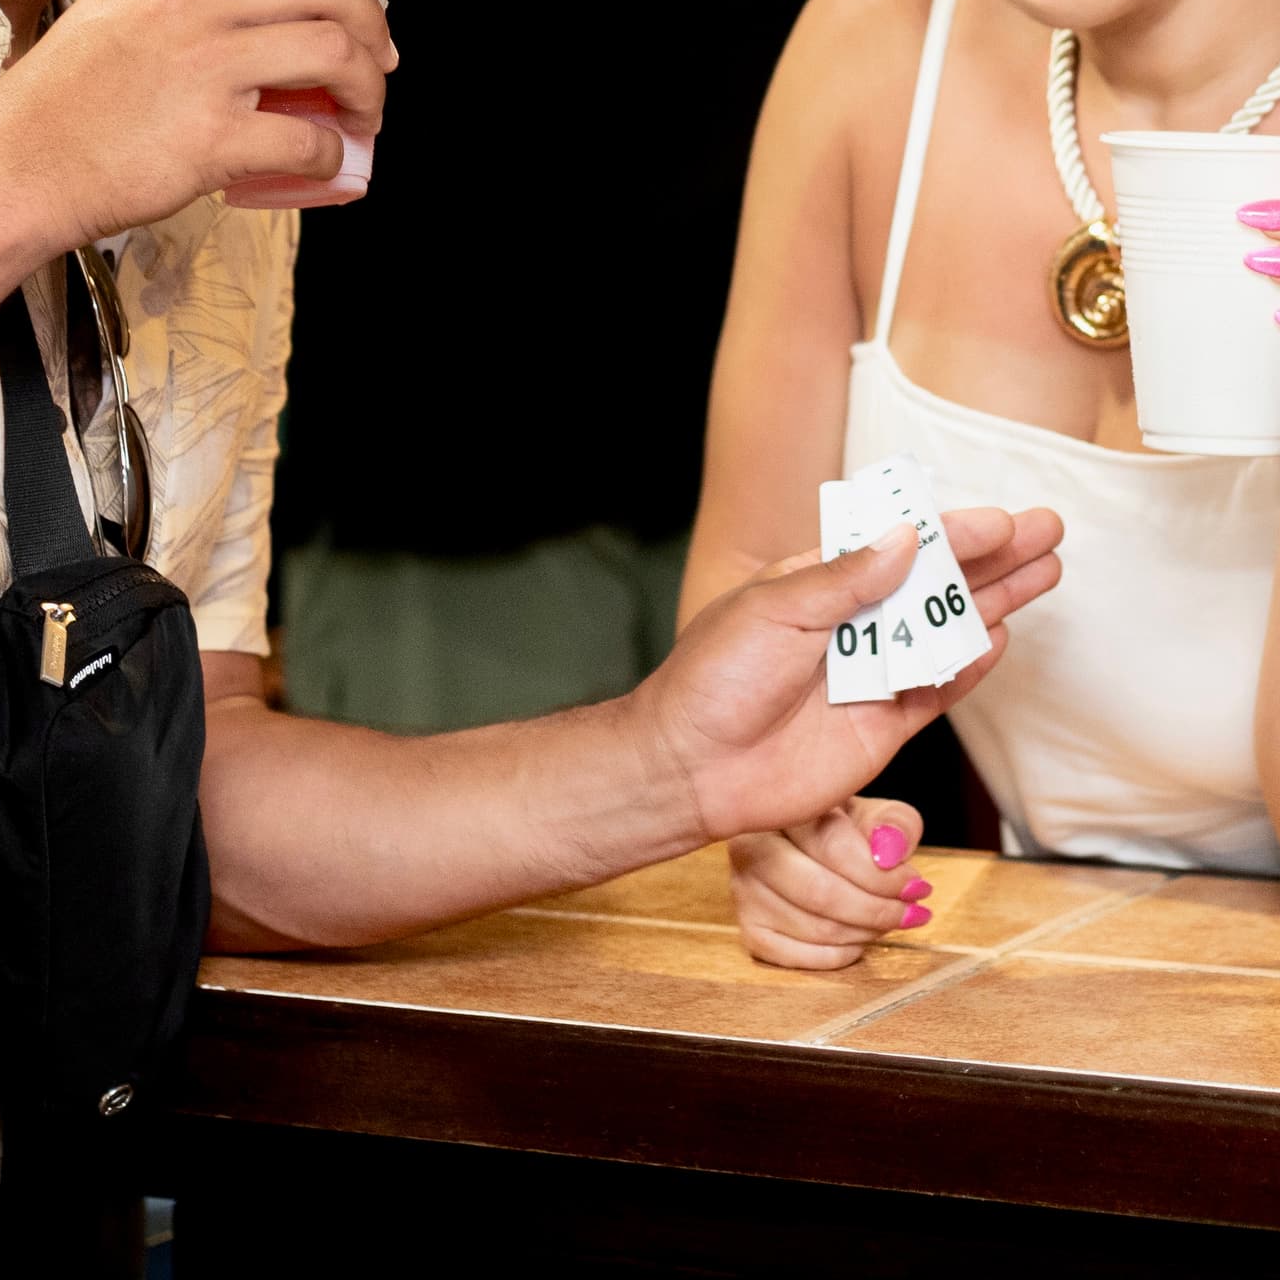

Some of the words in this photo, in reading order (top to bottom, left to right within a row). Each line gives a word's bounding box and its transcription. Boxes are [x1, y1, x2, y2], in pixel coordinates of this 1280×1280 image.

[924, 583, 967, 628] 06
[836, 621, 879, 657] 01
[69, 653, 112, 689] lululemon
